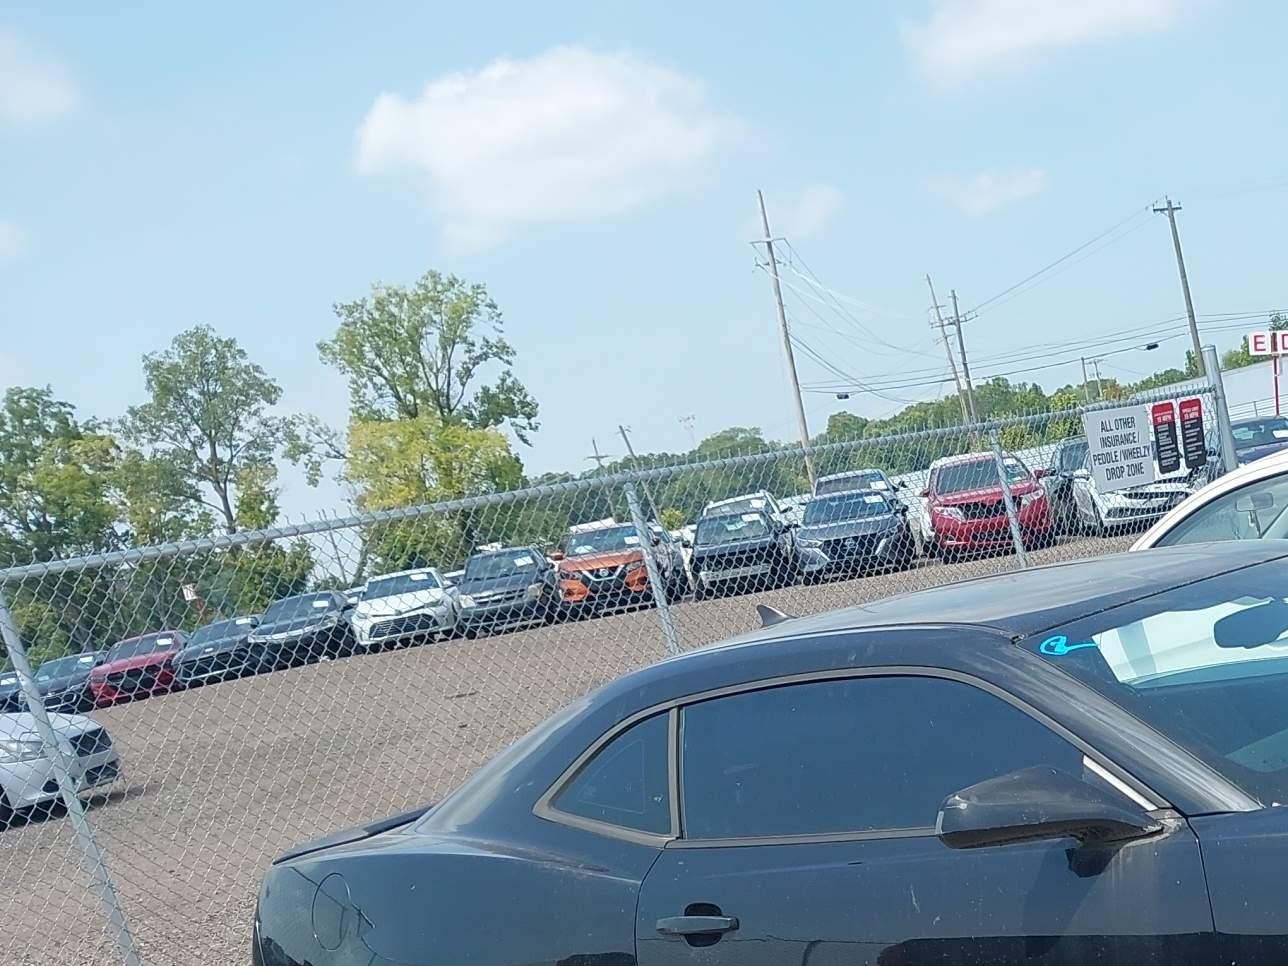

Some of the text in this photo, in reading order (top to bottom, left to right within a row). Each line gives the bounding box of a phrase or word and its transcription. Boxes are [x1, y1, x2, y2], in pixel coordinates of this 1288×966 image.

[1101, 416, 1135, 432] ALL OTHER
[1105, 462, 1145, 481] DROP ZONE
